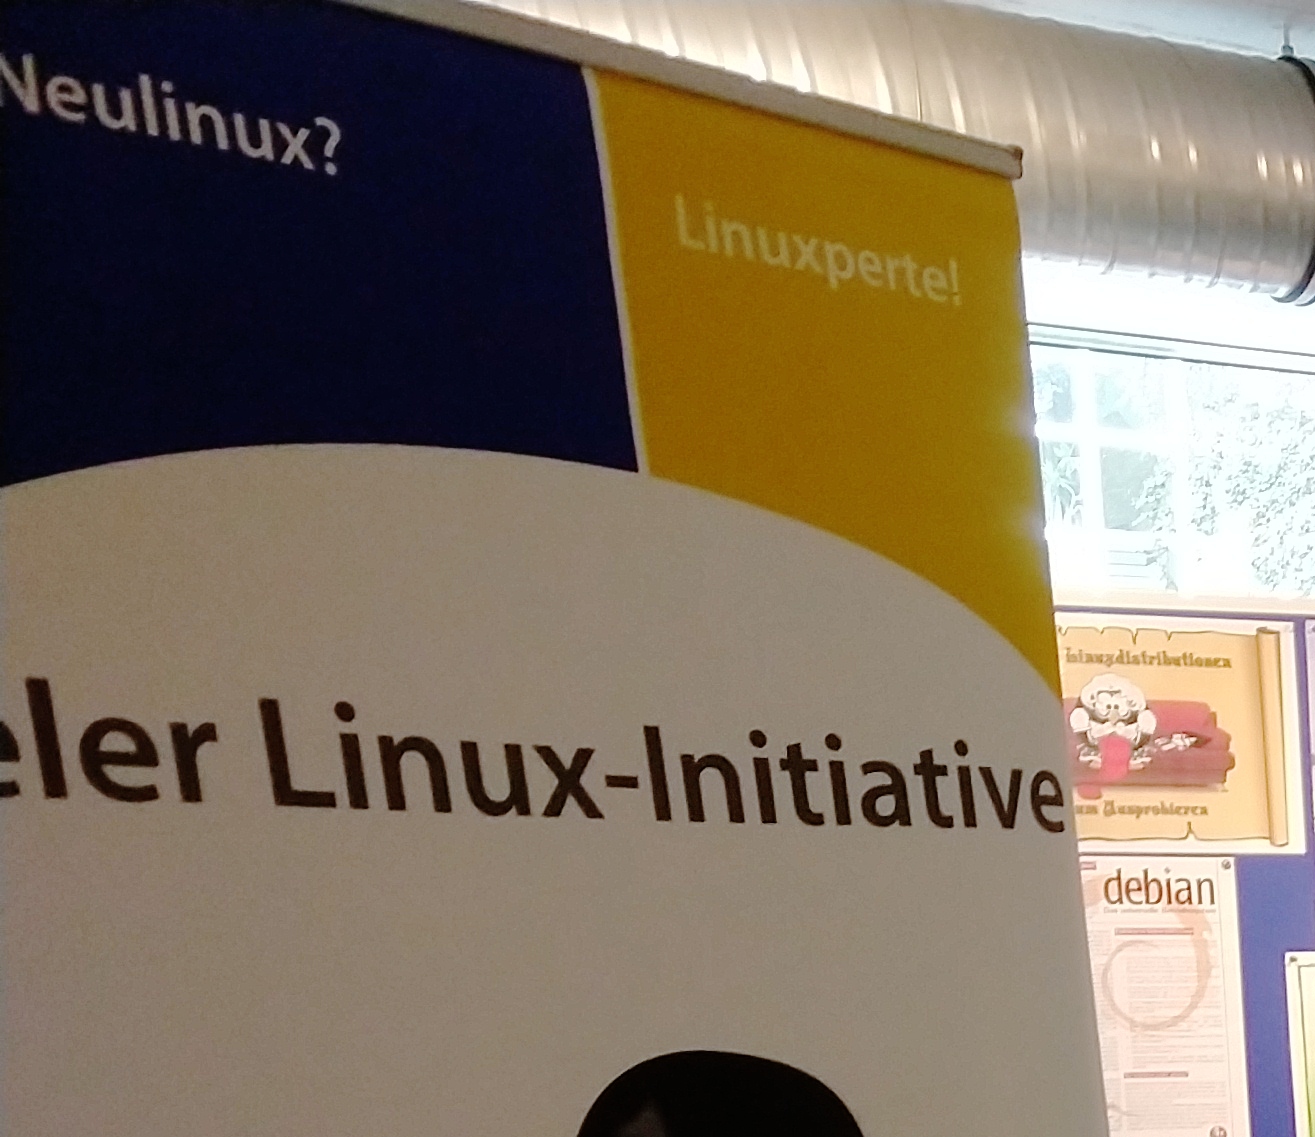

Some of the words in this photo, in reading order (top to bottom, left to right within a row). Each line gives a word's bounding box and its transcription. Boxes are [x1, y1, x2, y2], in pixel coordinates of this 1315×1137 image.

[0, 52, 342, 176] Neulinux?
[674, 194, 963, 306] Linuxperte!
[0, 676, 218, 803] ler
[258, 698, 1066, 834] Linux-Initiative
[1103, 867, 1216, 906] debian
